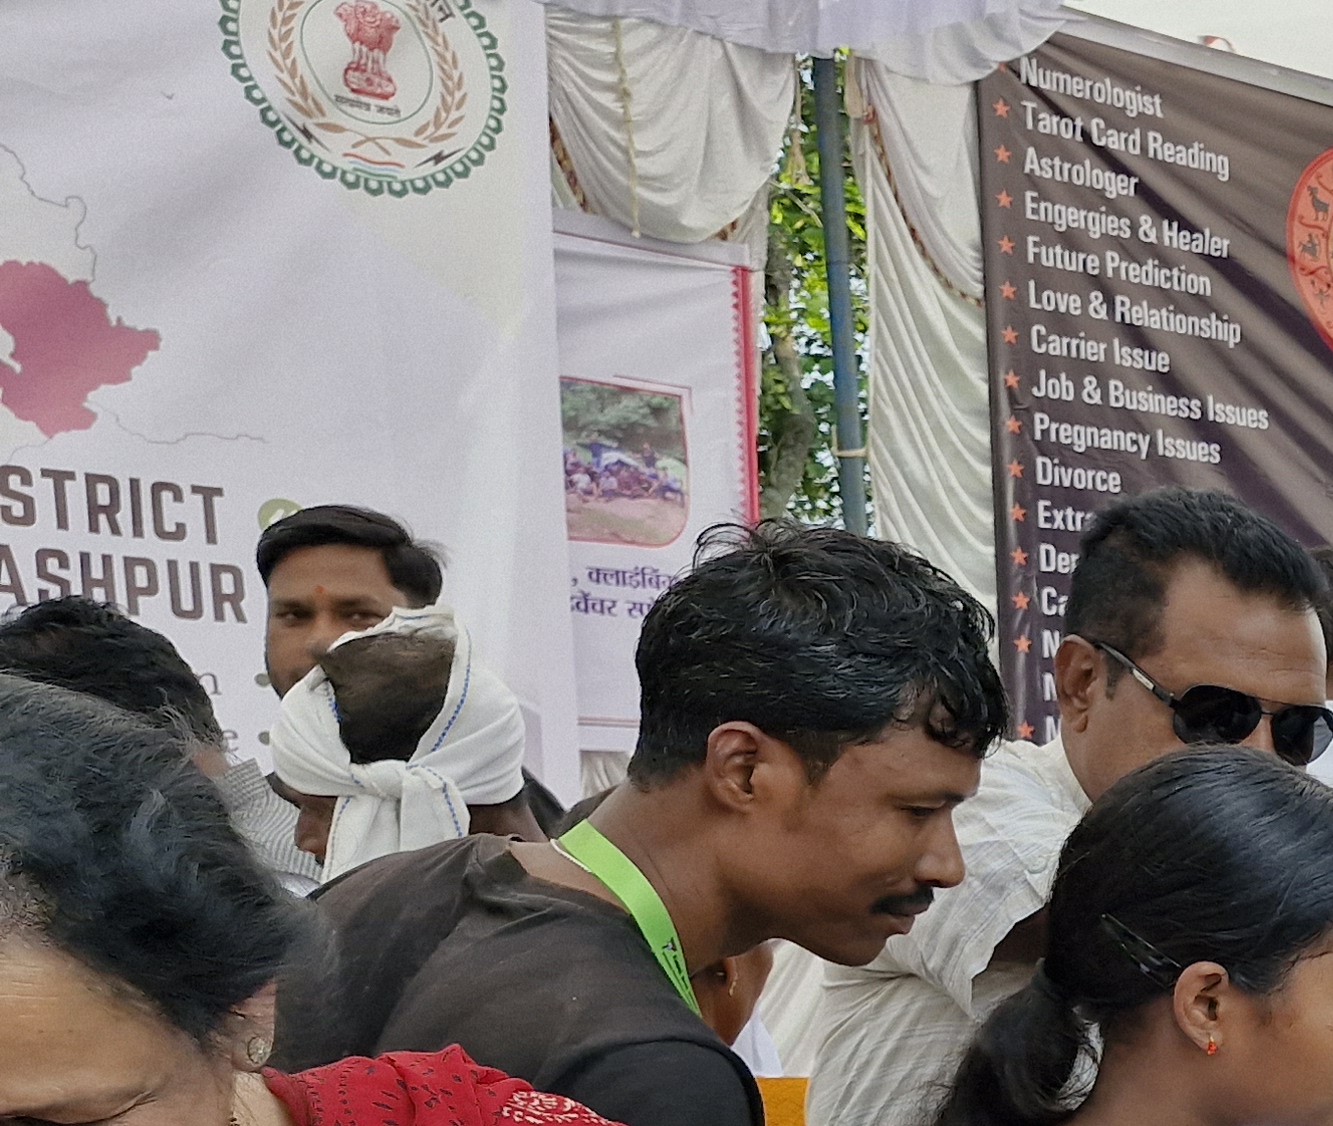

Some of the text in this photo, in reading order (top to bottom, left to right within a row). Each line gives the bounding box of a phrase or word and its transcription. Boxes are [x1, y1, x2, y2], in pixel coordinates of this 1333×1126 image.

[1020, 57, 1163, 118] Numerologist
[1022, 101, 1231, 183] Tarot Card Reading
[1023, 146, 1140, 198] Astrologer
[1025, 191, 1231, 259] Engergies & Healer
[1027, 235, 1212, 297] Future Prediction
[1028, 279, 1242, 348] Love & Relationship
[1030, 324, 1170, 374] Carrier Issue
[1032, 370, 1269, 430] Job & Business Issues
[1034, 412, 1221, 464] Pregnancy Issues
[1036, 457, 1121, 494] Divorce
